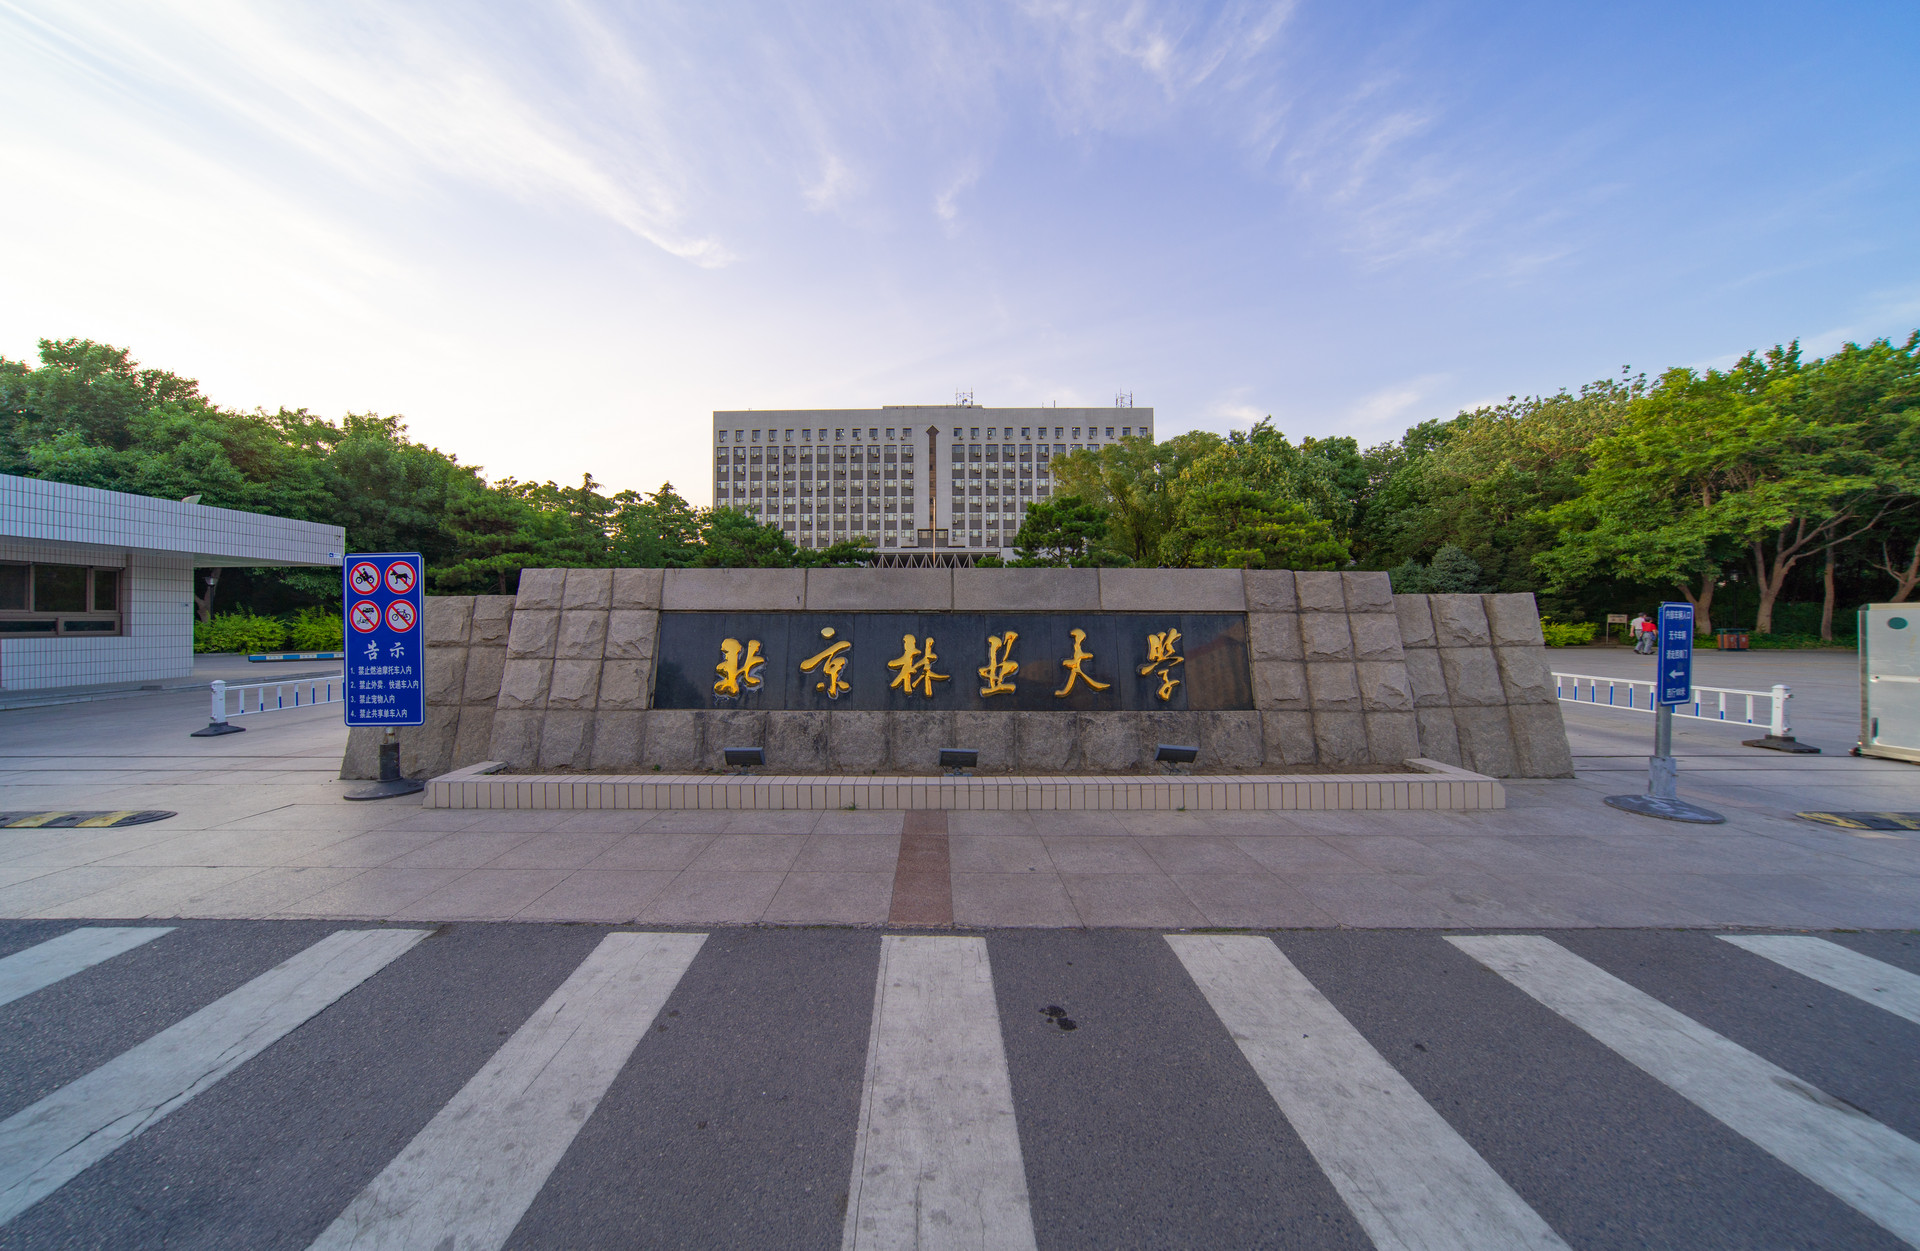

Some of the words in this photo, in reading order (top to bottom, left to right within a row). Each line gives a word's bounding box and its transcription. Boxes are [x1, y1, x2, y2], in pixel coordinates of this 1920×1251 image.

[363, 640, 404, 660] 告示
[359, 694, 395, 704] 禁止宠物入内
[359, 709, 407, 718] 禁止共享单车入内
